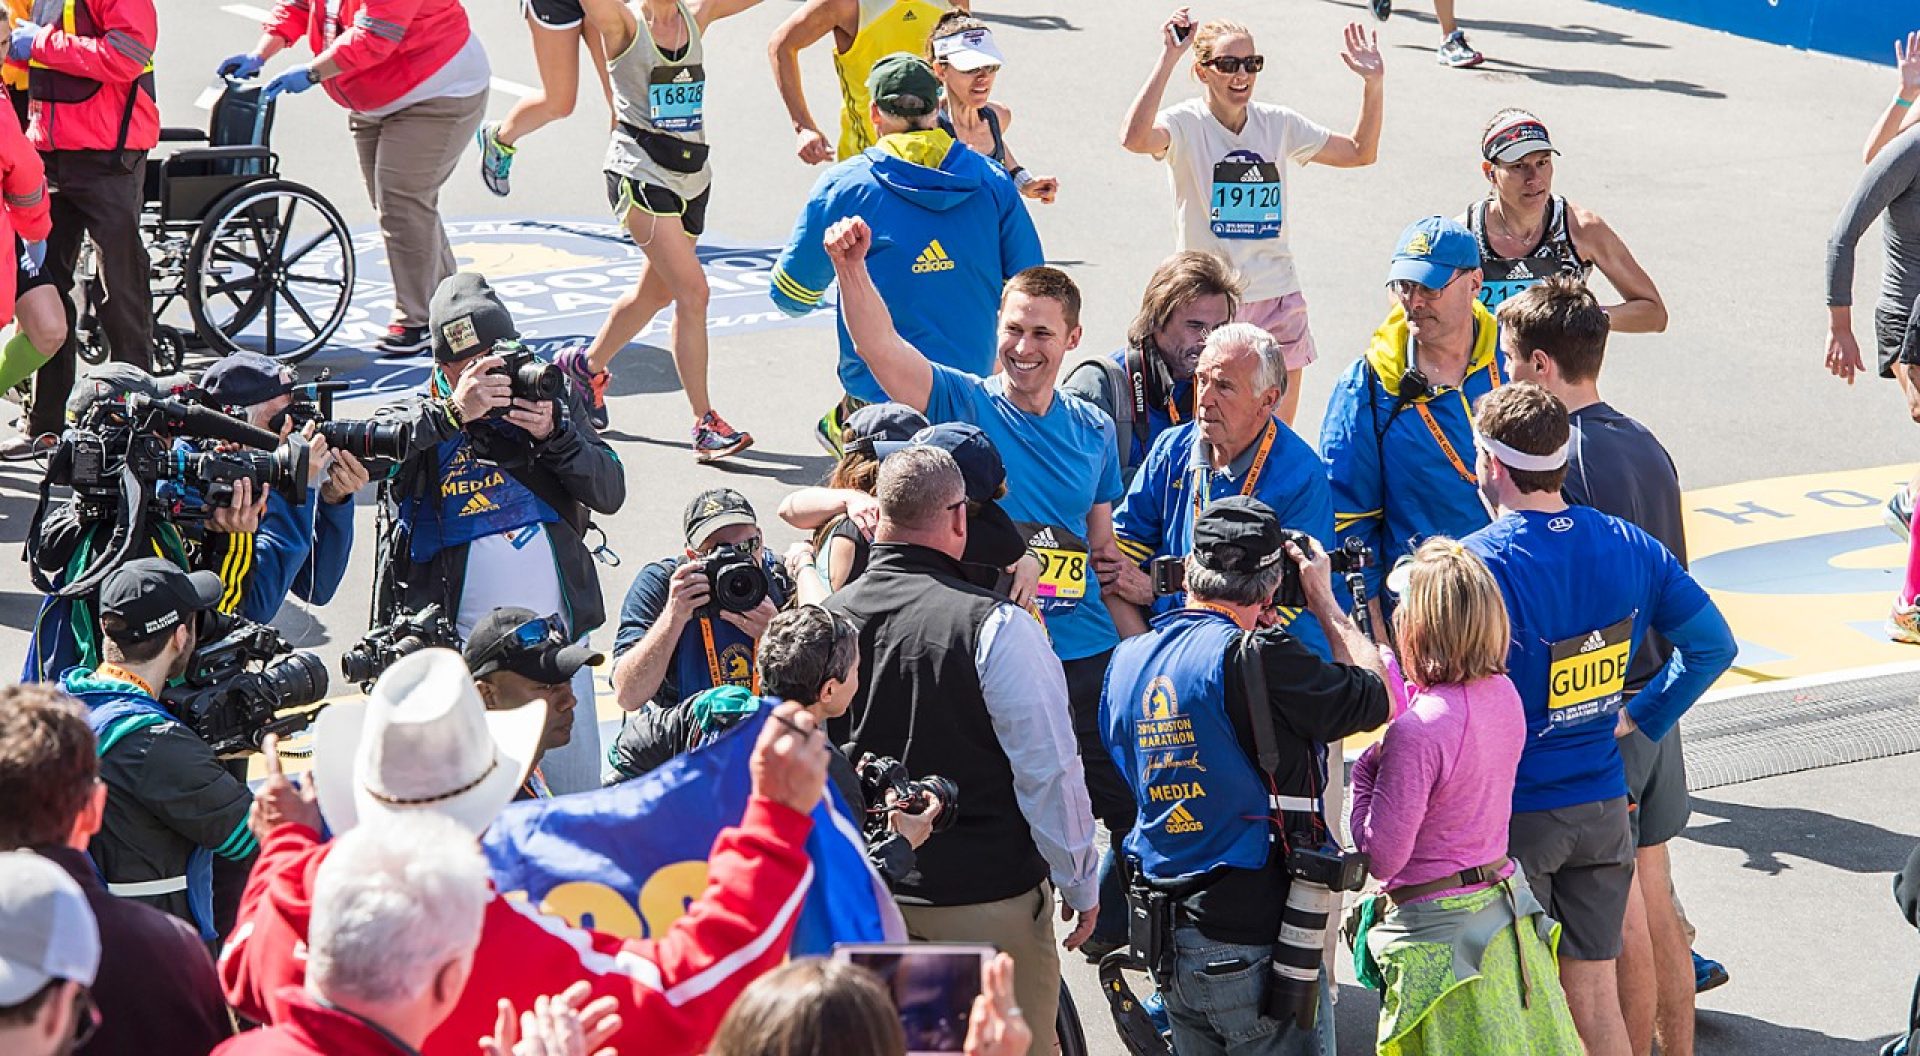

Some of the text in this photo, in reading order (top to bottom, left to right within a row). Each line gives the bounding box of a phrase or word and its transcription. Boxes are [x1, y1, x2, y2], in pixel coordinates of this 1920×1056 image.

[652, 83, 704, 106] 16828
[1217, 186, 1280, 208] 19120
[1212, 207, 1220, 218] 4
[912, 260, 955, 274] adidas
[440, 471, 505, 498] MEDIA
[1029, 539, 1060, 549] adidas
[1552, 652, 1628, 696] GUIDE
[1157, 718, 1192, 733] BOSTON
[1139, 731, 1195, 748] MARATHON
[1149, 780, 1207, 803] MEDIA
[1165, 821, 1204, 835] adidas
